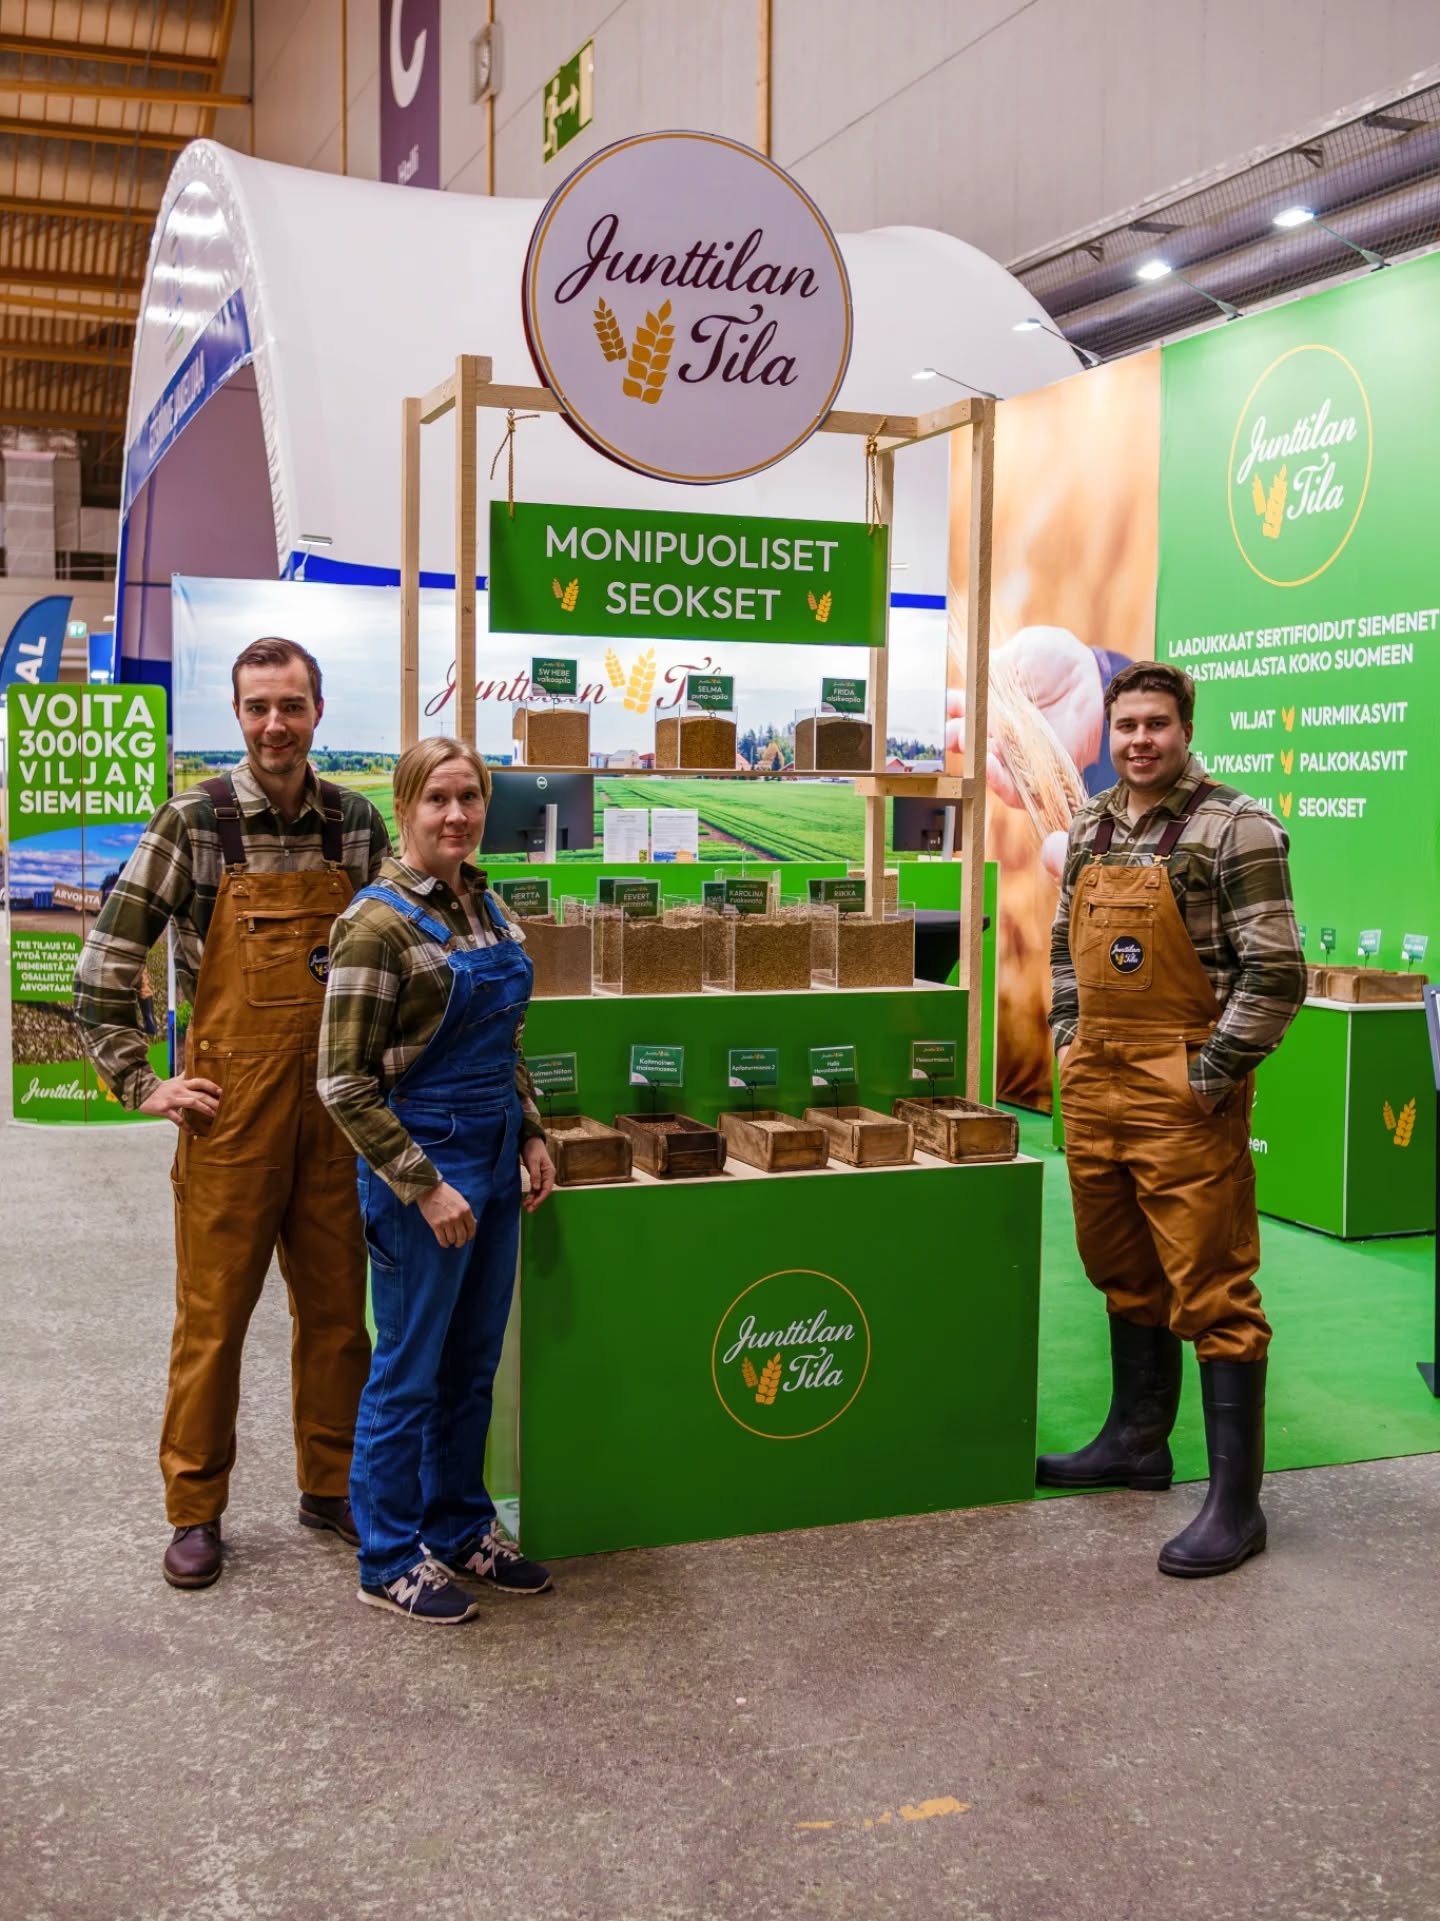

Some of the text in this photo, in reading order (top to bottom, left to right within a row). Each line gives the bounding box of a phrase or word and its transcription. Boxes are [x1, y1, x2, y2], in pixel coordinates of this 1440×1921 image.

[554, 213, 819, 304] Junttilan
[678, 304, 798, 386] Tila
[1236, 398, 1357, 484] Junttilan
[1286, 452, 1344, 520] Tila
[546, 525, 838, 572] MONIPUOLISET
[605, 581, 781, 620] SEOKSET
[1168, 608, 1439, 658] LAADUKKAAT SERTIFIOIDUT SIEMENET
[538, 668, 570, 677] SW HEBE
[1185, 643, 1414, 682] SASTAMALASTA KOKO SUOMEEN
[698, 685, 722, 693] SELMA
[833, 688, 854, 696] FRIDA
[18, 693, 155, 728] VOITA
[1230, 702, 1407, 730] VILJAT NURMIKASVIT
[18, 730, 156, 758] 3000KG
[19, 760, 155, 785] VILJAN
[1300, 750, 1407, 772] PALKOKASVIT
[19, 785, 155, 815] SIEMENIÄ
[1298, 798, 1366, 818] SEOKSET
[511, 891, 540, 900] HERTTA
[62, 942, 76, 950] TAI
[21, 1077, 98, 1104] Junttilan
[723, 1309, 855, 1364] Junttilan
[783, 1346, 843, 1392] Tila
